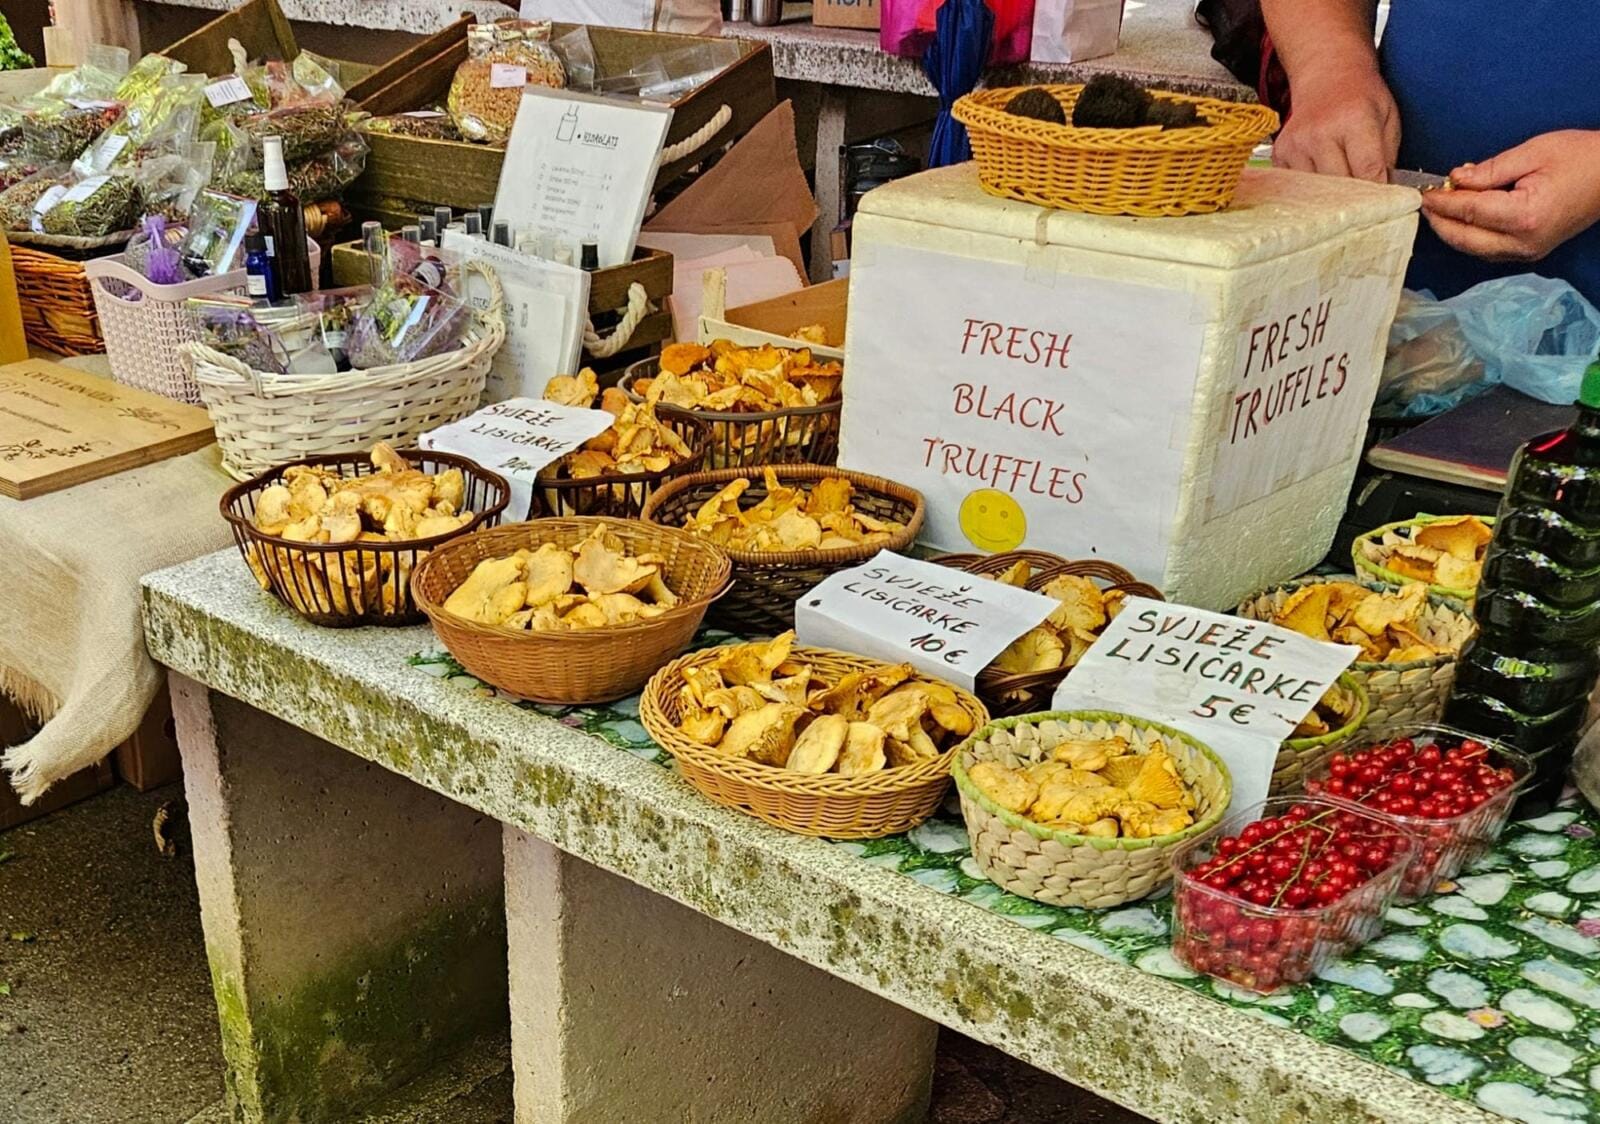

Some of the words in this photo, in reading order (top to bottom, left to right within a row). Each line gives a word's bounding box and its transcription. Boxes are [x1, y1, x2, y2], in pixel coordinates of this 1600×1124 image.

[960, 318, 1073, 369] FRESH
[1243, 297, 1333, 379] FRESH
[483, 403, 563, 428] SVJEŽE
[952, 383, 1065, 437] BLACK
[1231, 352, 1349, 445] TRUFFLES
[470, 423, 573, 452] LISIČARKE
[923, 437, 1088, 504] TRUFFLES
[863, 567, 983, 609] SVJEŽE
[1127, 609, 1286, 660] SVJEŽE
[1105, 637, 1325, 703] LISIČARKE
